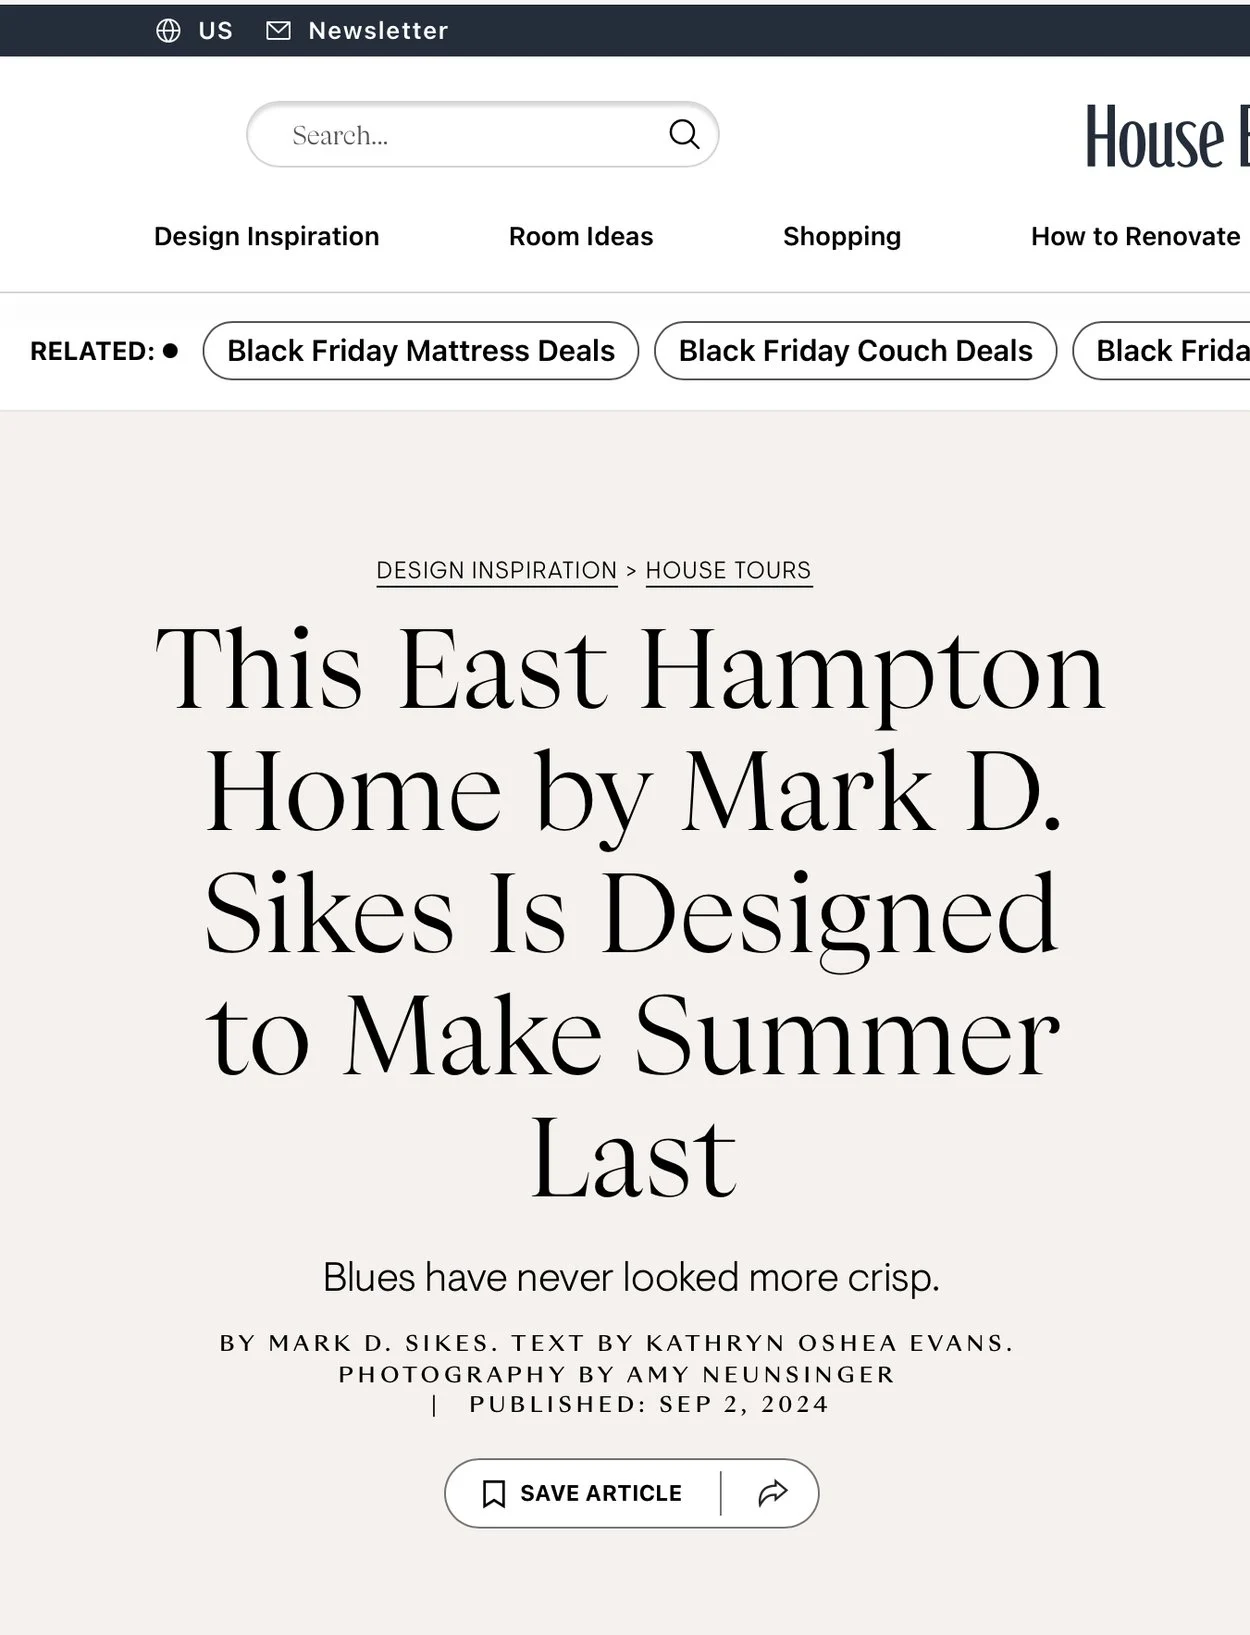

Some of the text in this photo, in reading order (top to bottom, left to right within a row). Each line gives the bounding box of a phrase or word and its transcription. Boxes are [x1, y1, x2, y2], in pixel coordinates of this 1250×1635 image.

[199, 20, 233, 41] US
[309, 20, 449, 40] Newsletter
[292, 124, 388, 146] Search...
[1086, 103, 1225, 169] House
[154, 224, 380, 251] Design Inspiration
[509, 225, 654, 247] Room Ideas
[783, 224, 901, 251] Shopping
[1031, 226, 1241, 247] How to Renovate
[30, 340, 155, 361] RELATED:
[228, 337, 616, 368] Black Friday Mattress Deals
[679, 337, 1034, 368] Black Friday Couch Deals
[1097, 338, 1174, 362] Black
[377, 560, 464, 580] DESIGN
[472, 560, 616, 580] INSPIRATION
[646, 560, 727, 580] HOUSE
[734, 560, 811, 580] TOURS
[155, 624, 1107, 732] This East Hampton
[206, 747, 1060, 853] Home by Mark D.
[206, 869, 1059, 976] Sikes Is Designed
[204, 991, 1061, 1076] to Make Summer
[531, 1116, 737, 1198] Last
[324, 1260, 940, 1300] Blues have never looked more crisp.
[220, 1333, 1012, 1352] BY MARK D. SIKES. TEXT BY KATHRYN OSHEA EVANS.
[339, 1365, 894, 1384] PHOTOGRAPHY BY AMY NEUNSINGER
[470, 1395, 644, 1413] PUBLISHED:
[659, 1395, 711, 1413] SEP
[723, 1395, 747, 1417] 2,
[761, 1395, 828, 1413] 2024
[520, 1483, 682, 1503] SAVE ARTICLE
